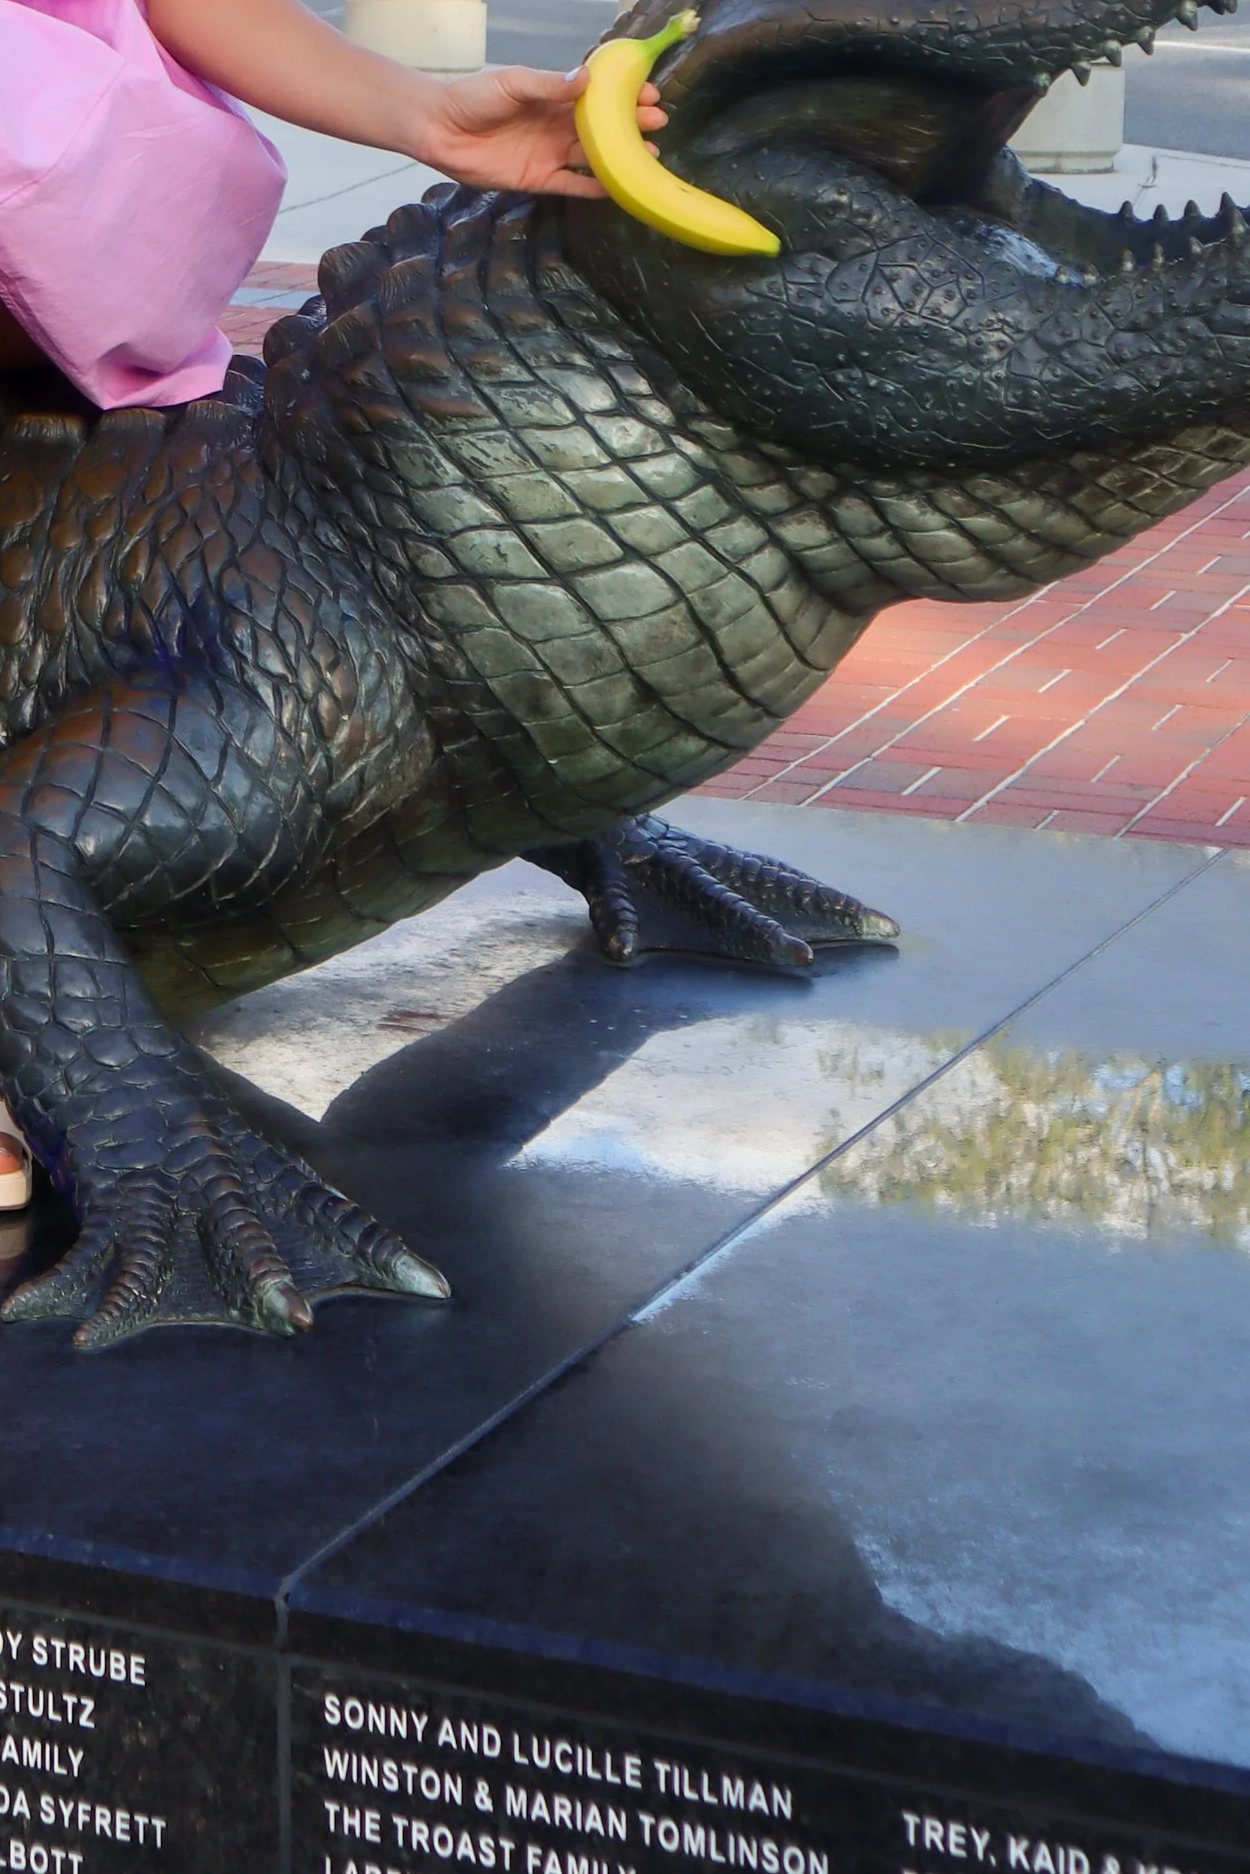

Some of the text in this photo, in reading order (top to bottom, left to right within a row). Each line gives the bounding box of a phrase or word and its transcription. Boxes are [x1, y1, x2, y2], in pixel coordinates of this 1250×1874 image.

[33, 1634, 145, 1686] STRUBE
[325, 1693, 791, 1819] SONNY AND LUCILLE TILLMAN
[40, 1794, 166, 1848] SYFRETT
[324, 1748, 828, 1874] WINSTON & MARIAN TOMLINSON
[324, 1801, 380, 1842] THE
[392, 1815, 515, 1870] TROAST
[902, 1811, 996, 1866] TREY,
[1007, 1834, 1090, 1874] KAID
